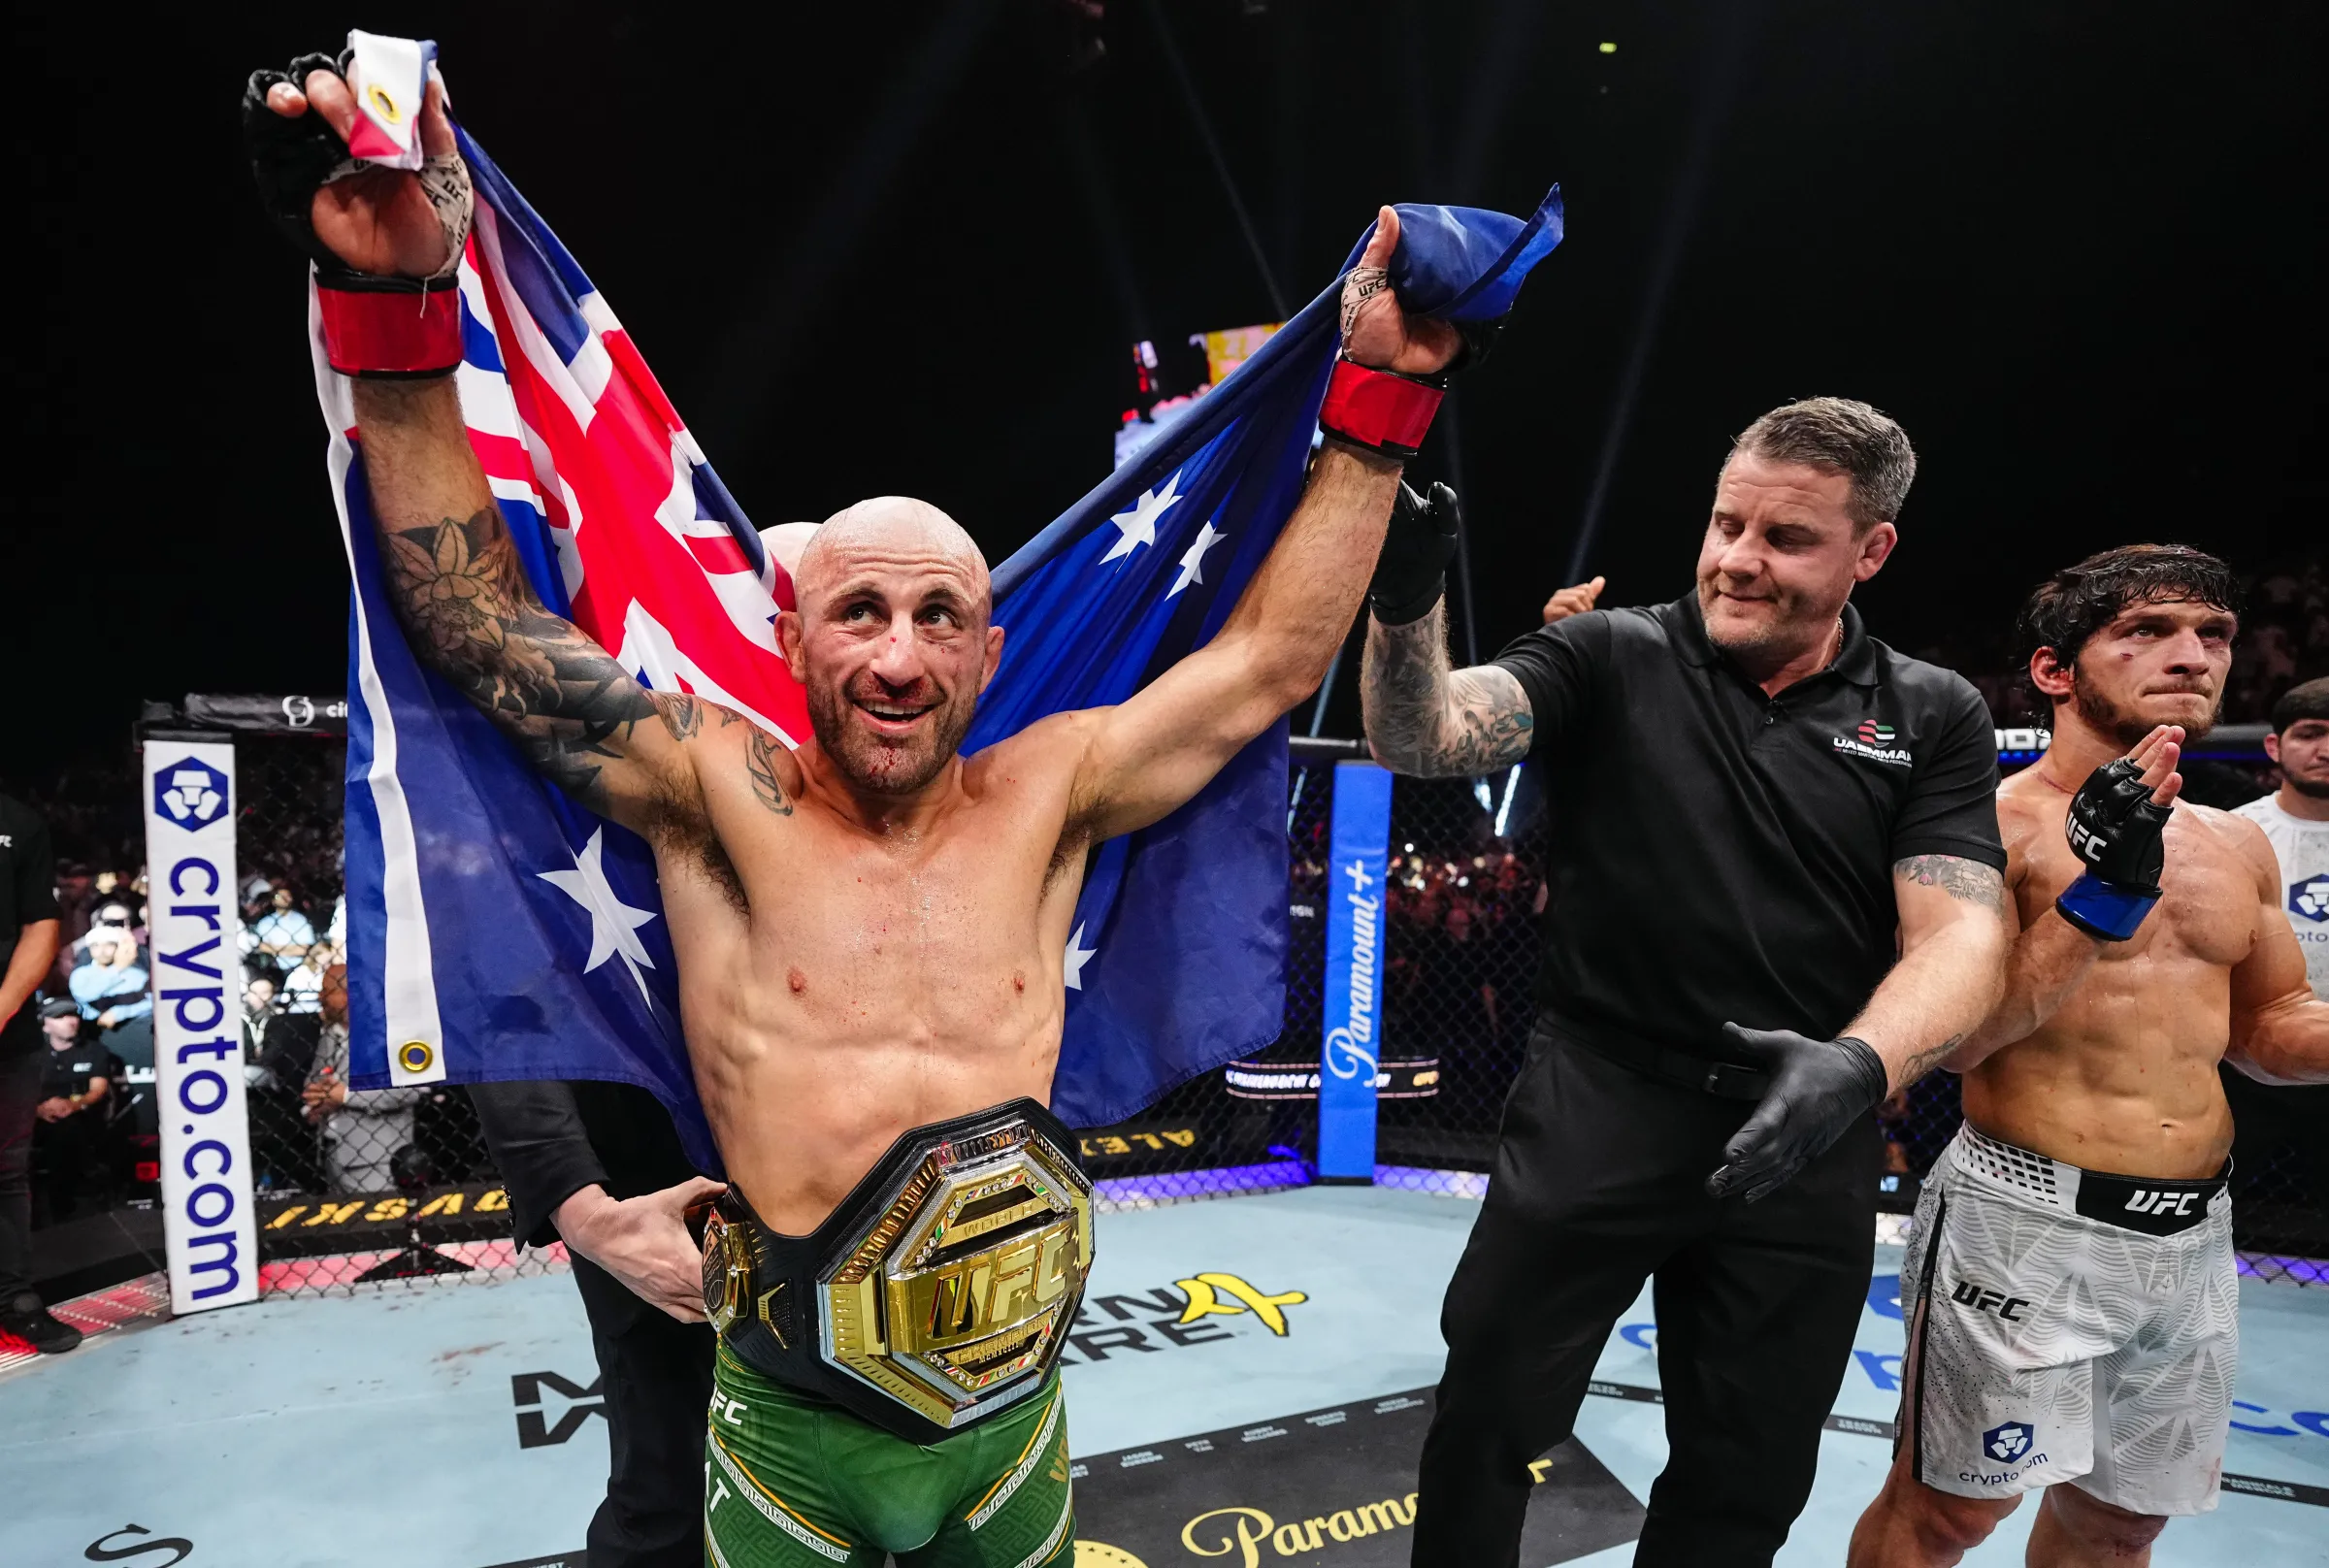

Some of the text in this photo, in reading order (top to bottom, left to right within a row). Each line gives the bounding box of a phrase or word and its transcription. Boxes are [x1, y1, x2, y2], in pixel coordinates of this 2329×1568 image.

[1359, 277, 1385, 297] UFC
[2065, 811, 2108, 863] UFC
[157, 856, 240, 1301] crypto.com
[264, 1190, 509, 1230] OVSKI
[2124, 1190, 2200, 1216] UFC
[928, 1225, 1072, 1342] UFC
[1951, 1281, 2031, 1323] UFC
[1958, 1453, 2049, 1486] cryptoom
